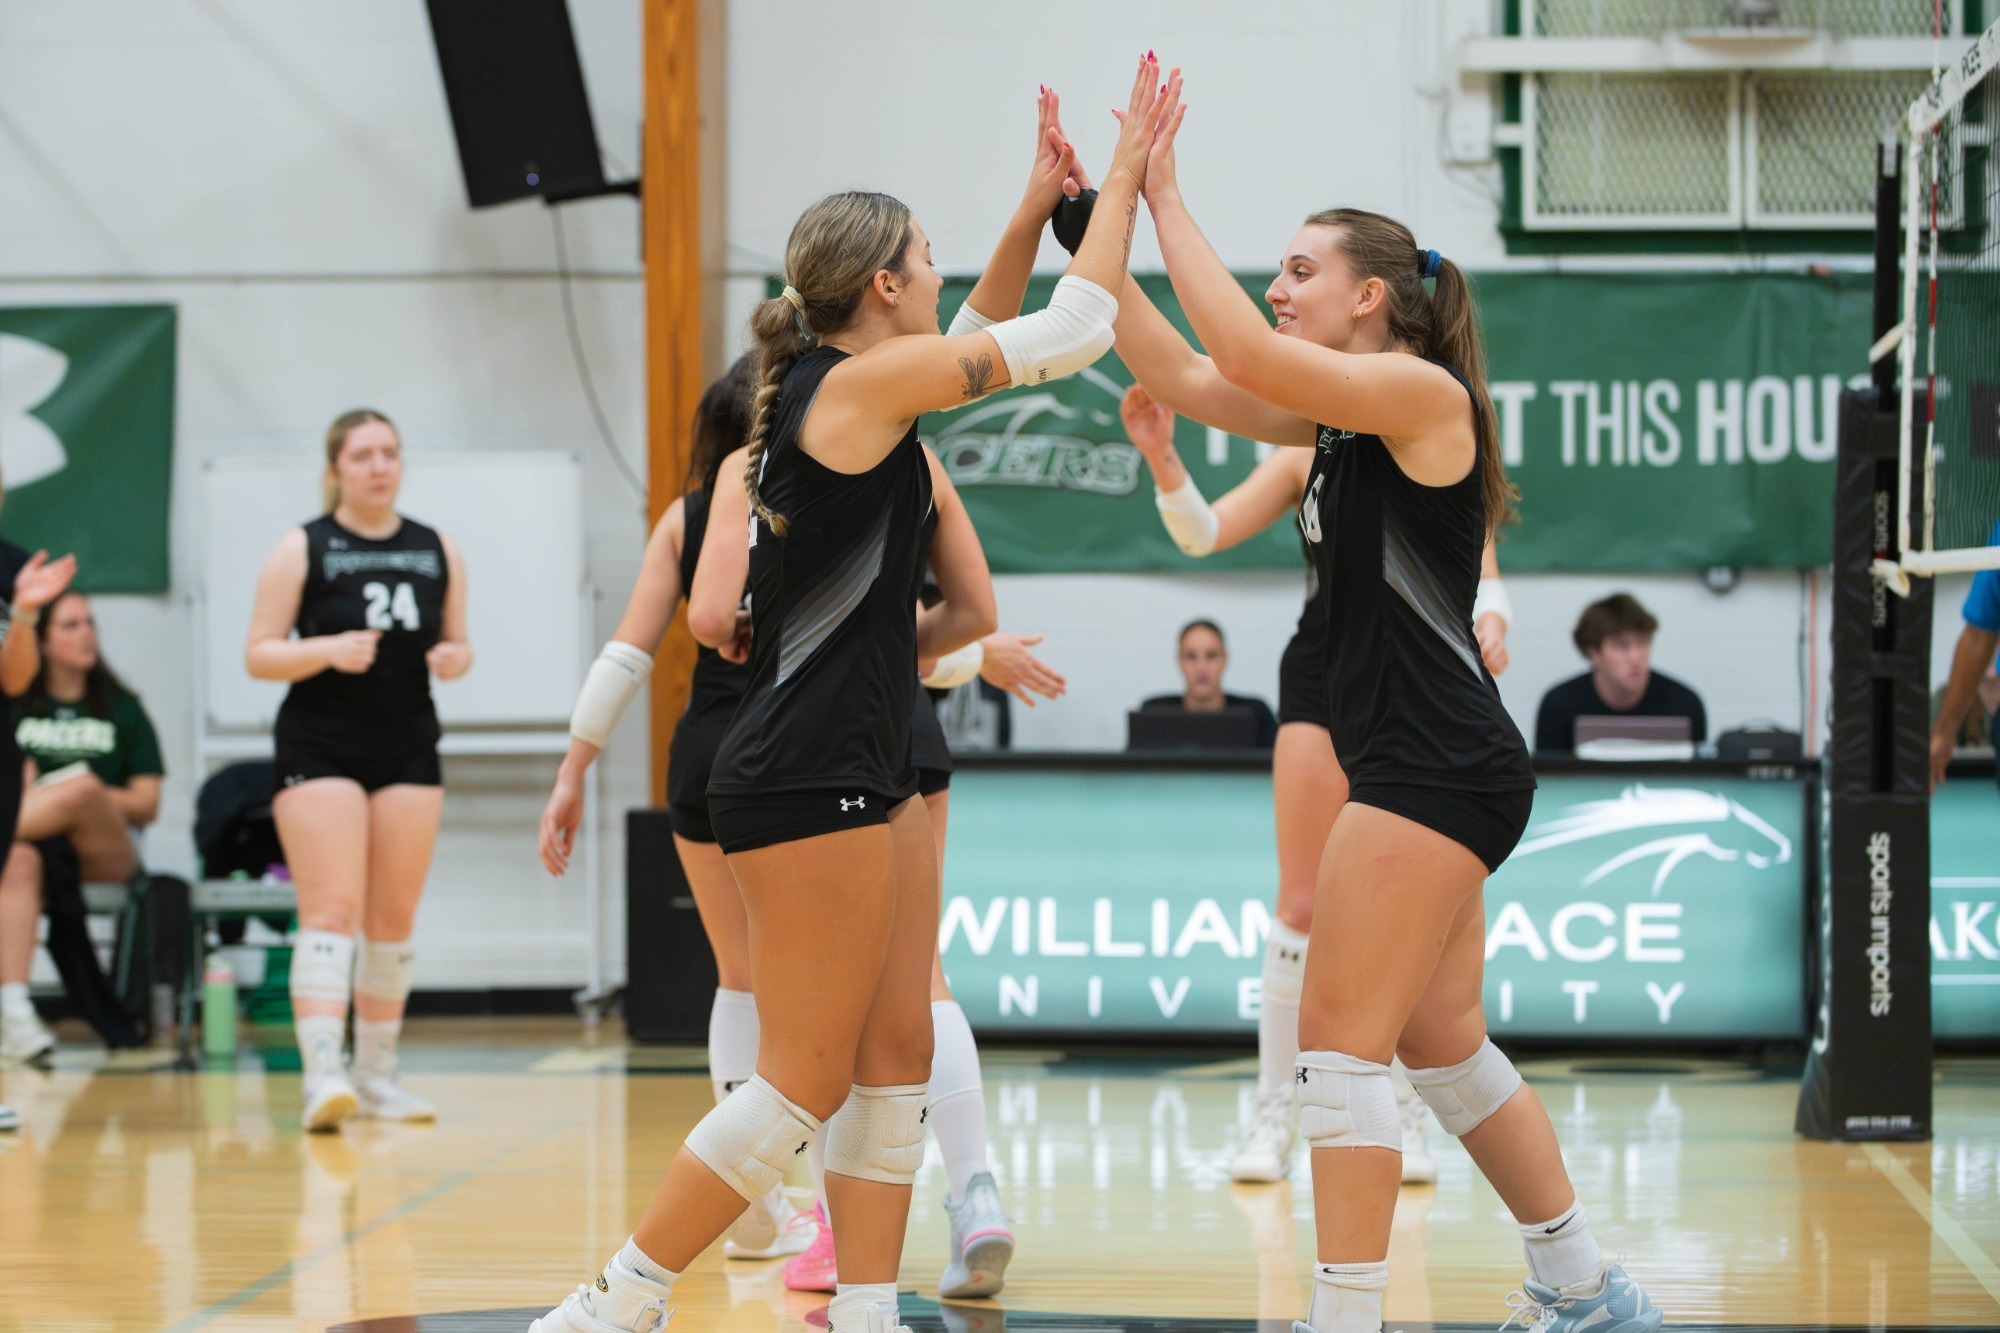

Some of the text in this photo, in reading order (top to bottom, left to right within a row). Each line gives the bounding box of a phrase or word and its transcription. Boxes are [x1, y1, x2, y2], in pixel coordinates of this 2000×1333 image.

[1550, 379, 1683, 467] THIS
[1697, 374, 1868, 466] HOU
[362, 581, 421, 631] 24
[1484, 902, 1685, 962] ACE
